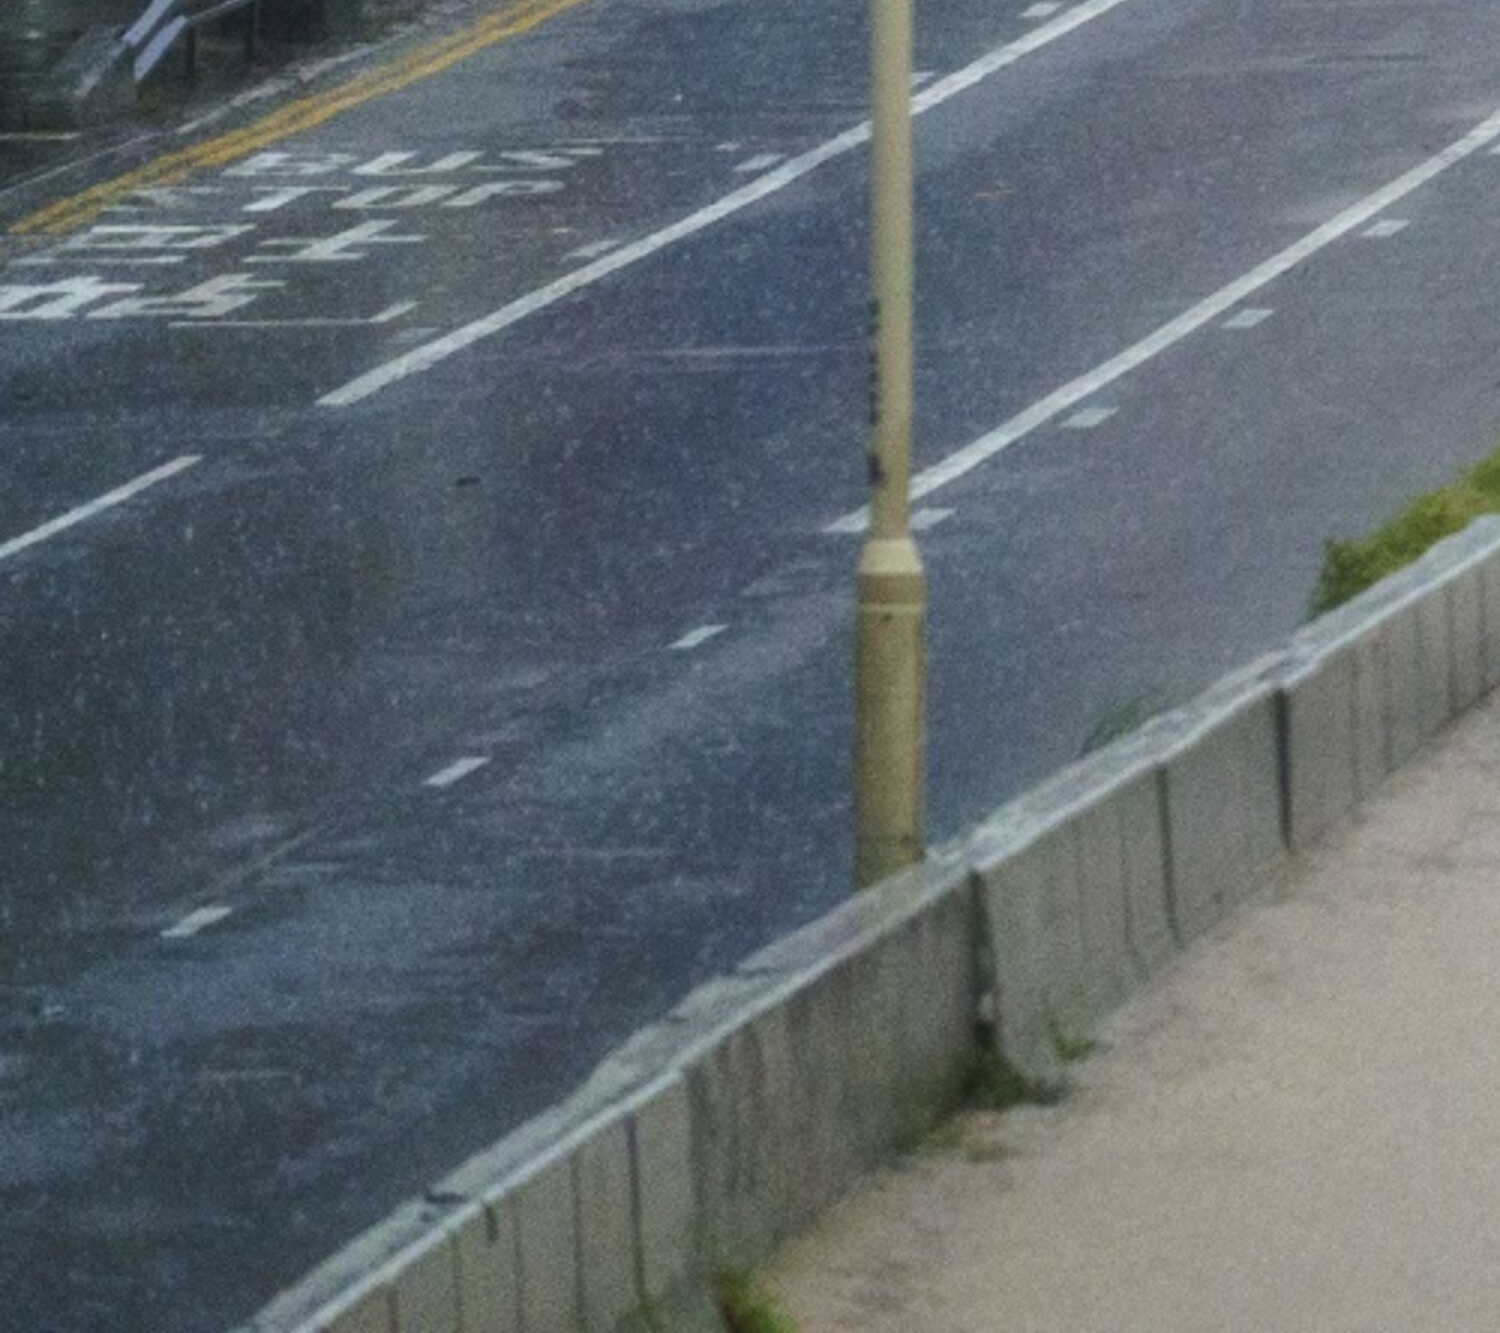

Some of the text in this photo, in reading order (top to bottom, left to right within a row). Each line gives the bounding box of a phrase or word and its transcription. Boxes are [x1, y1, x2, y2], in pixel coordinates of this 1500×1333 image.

[222, 146, 605, 179] BUS
[98, 180, 567, 213] STOP
[14, 218, 430, 265] 巴士
